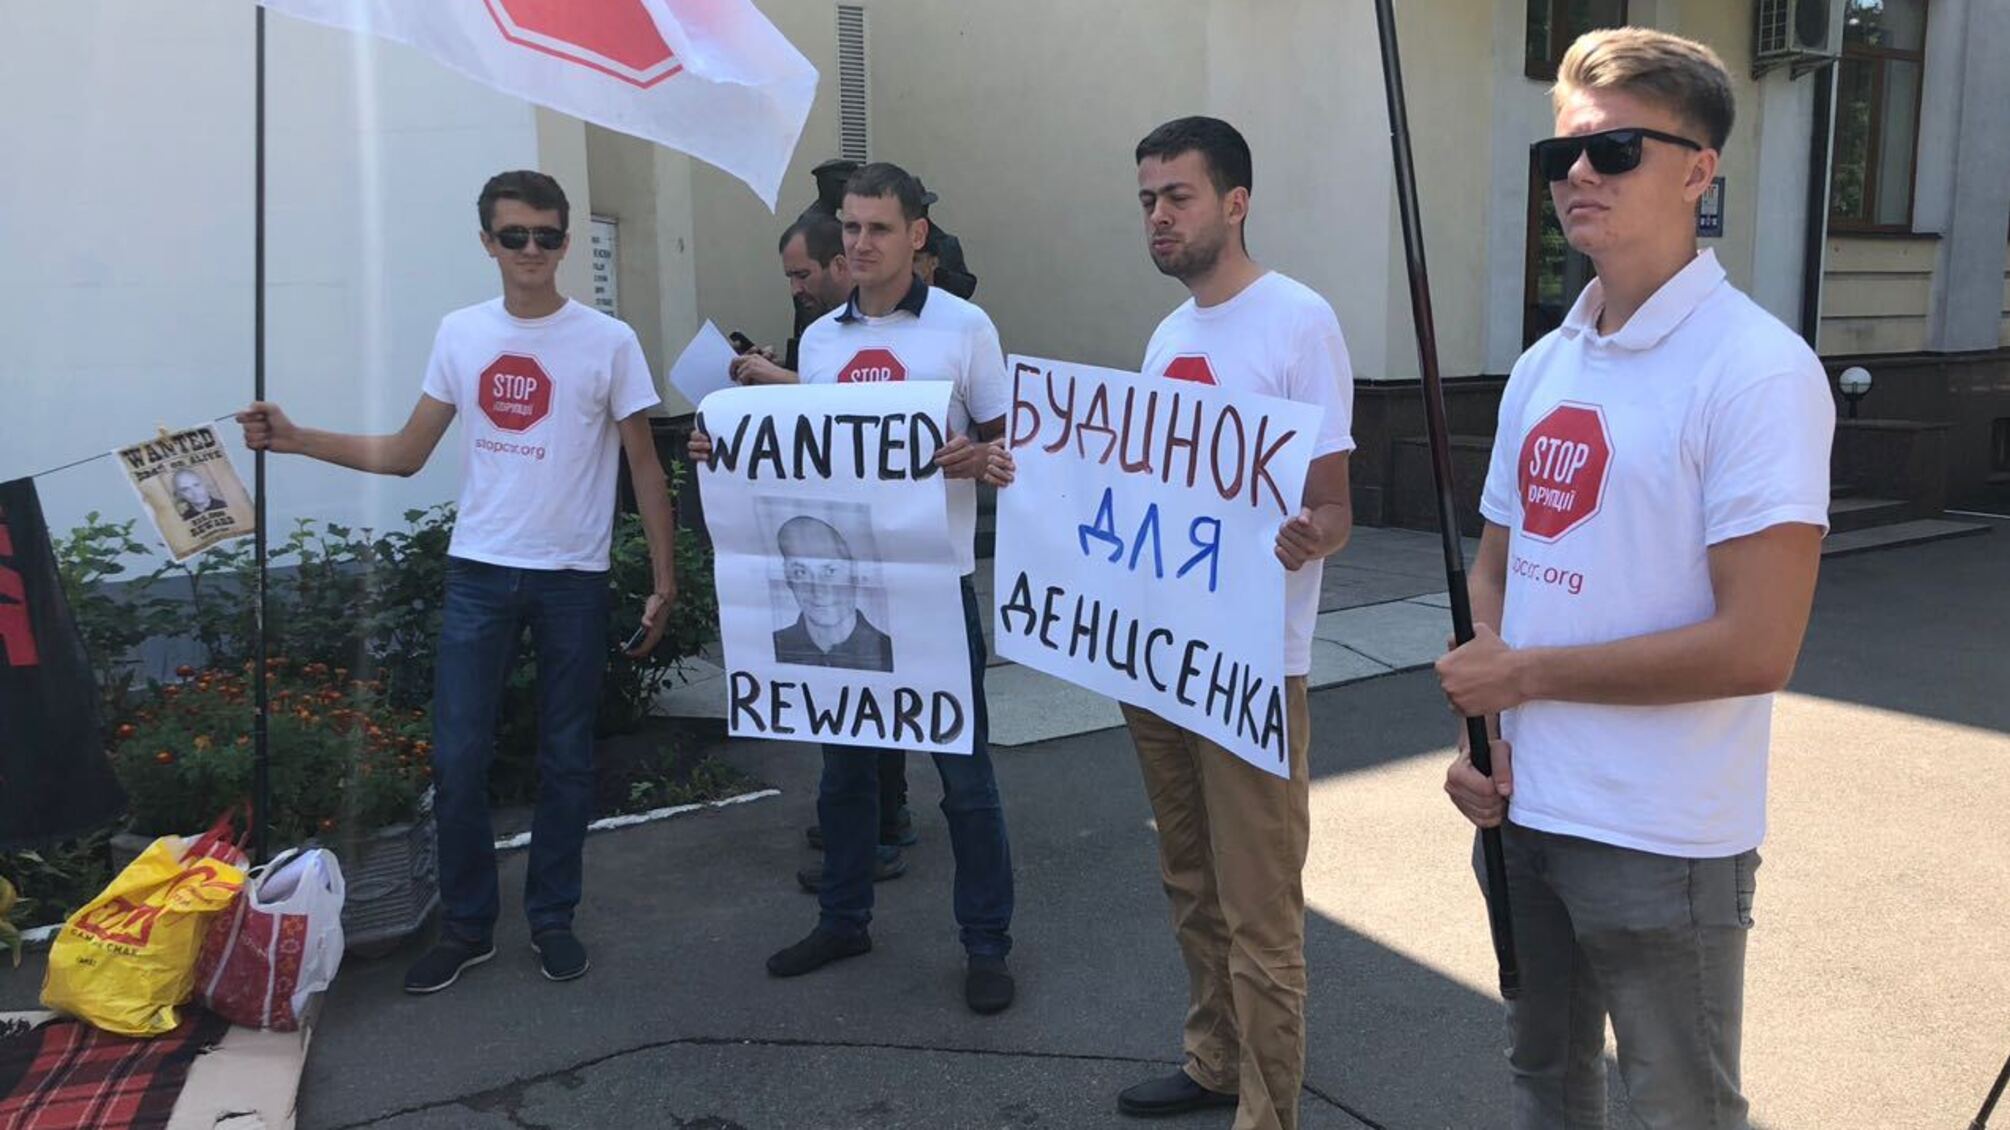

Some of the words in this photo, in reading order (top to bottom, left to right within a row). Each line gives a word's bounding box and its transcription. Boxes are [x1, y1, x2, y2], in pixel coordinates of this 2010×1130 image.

[493, 372, 538, 400] STOP
[850, 367, 891, 383] STOP
[118, 427, 216, 469] WANTED
[697, 410, 944, 481] WANTED
[1009, 361, 1298, 517] БУДИНОК
[1529, 435, 1589, 484] STOP
[1528, 484, 1577, 513] ОРУПЦІЇ
[1077, 486, 1222, 593] ДЛЯ
[1000, 570, 1286, 763] ДЕНИСЕНКА
[728, 670, 965, 744] REWARD
